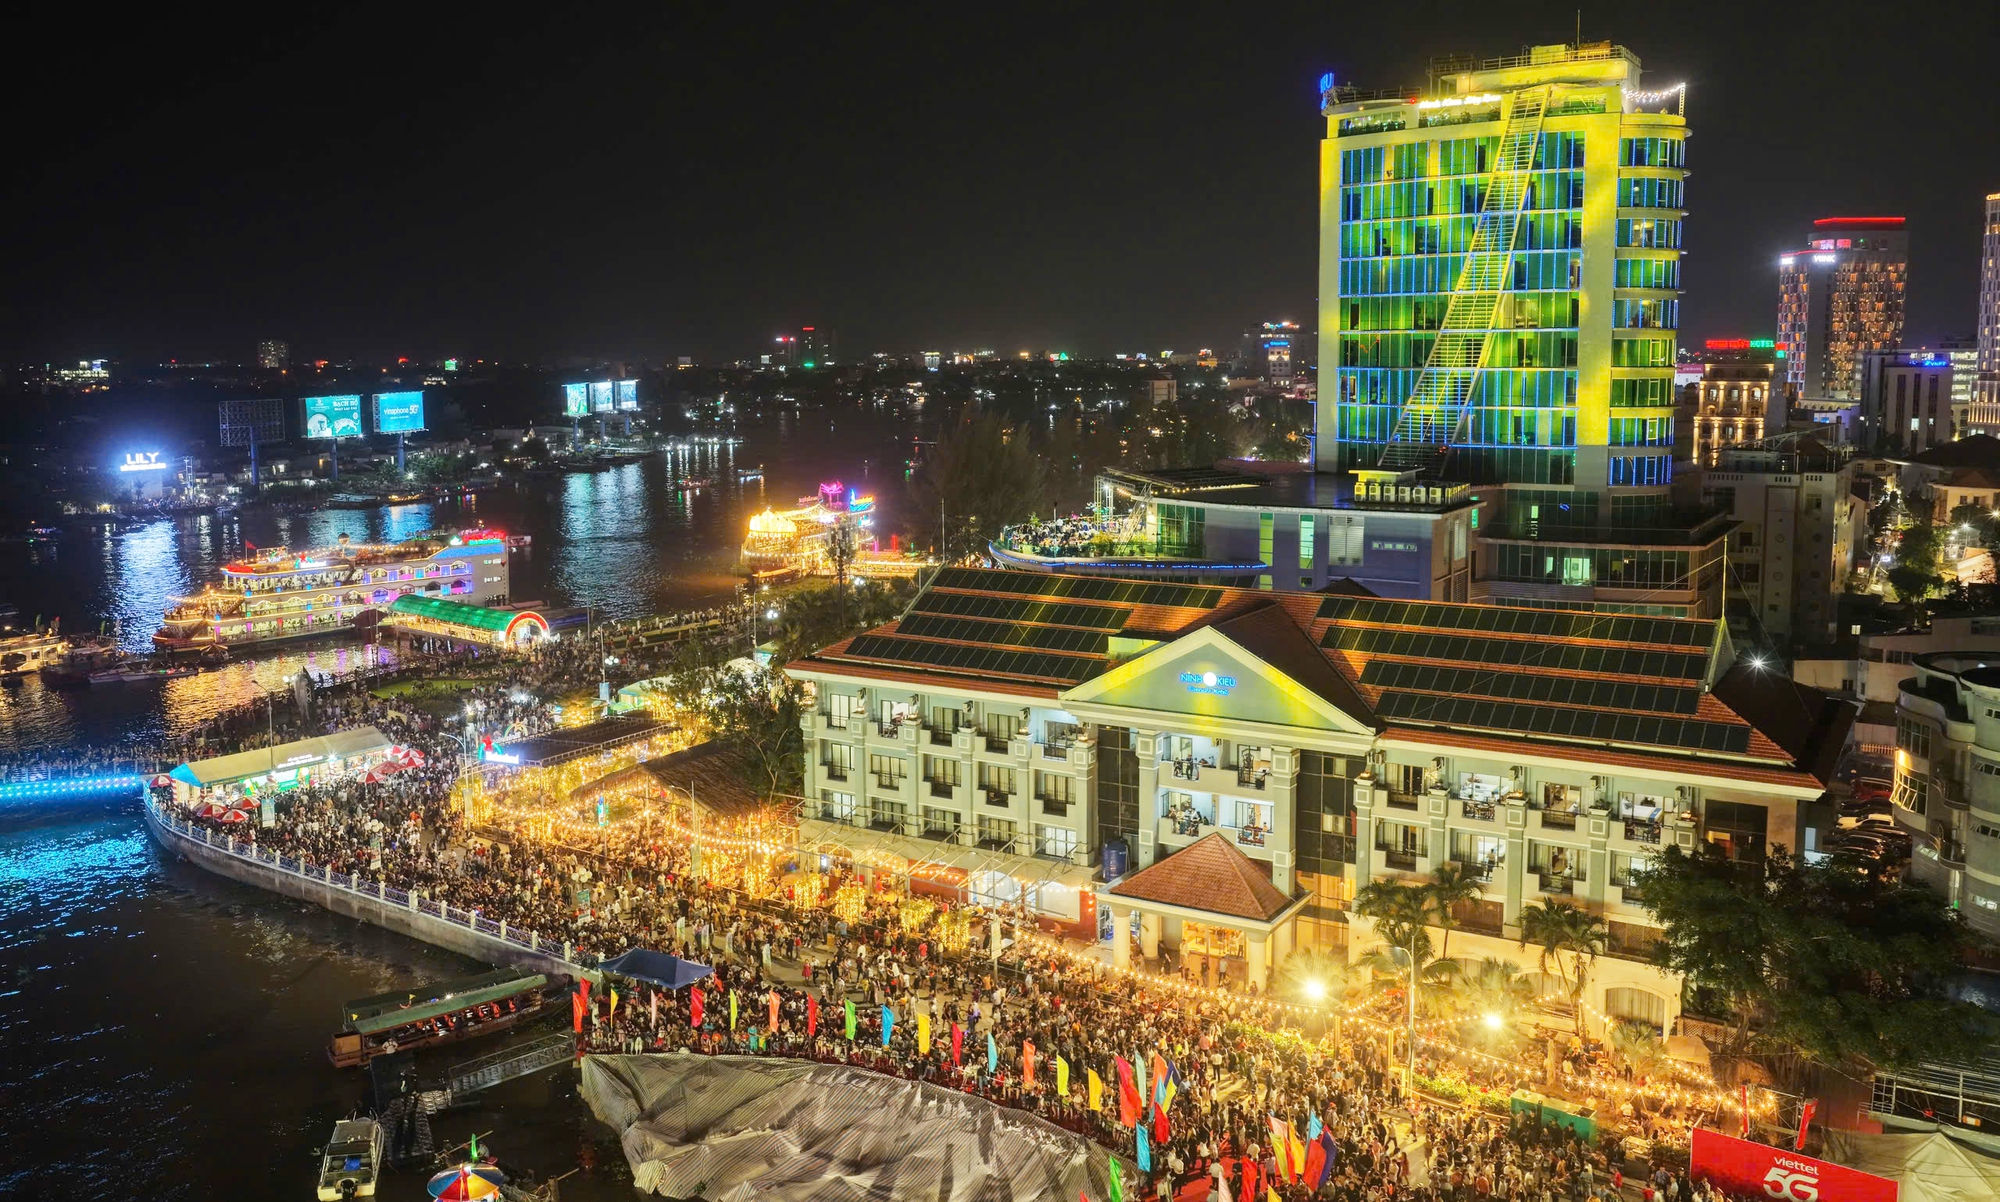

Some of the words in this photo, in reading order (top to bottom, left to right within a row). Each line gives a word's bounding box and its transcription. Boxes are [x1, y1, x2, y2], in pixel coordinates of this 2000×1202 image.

[1750, 340, 1775, 348] HOTEL
[383, 407, 408, 415] vinaphone
[126, 452, 159, 464] LILY
[1774, 1156, 1819, 1176] viettel
[1763, 1167, 1819, 1202] 5G
